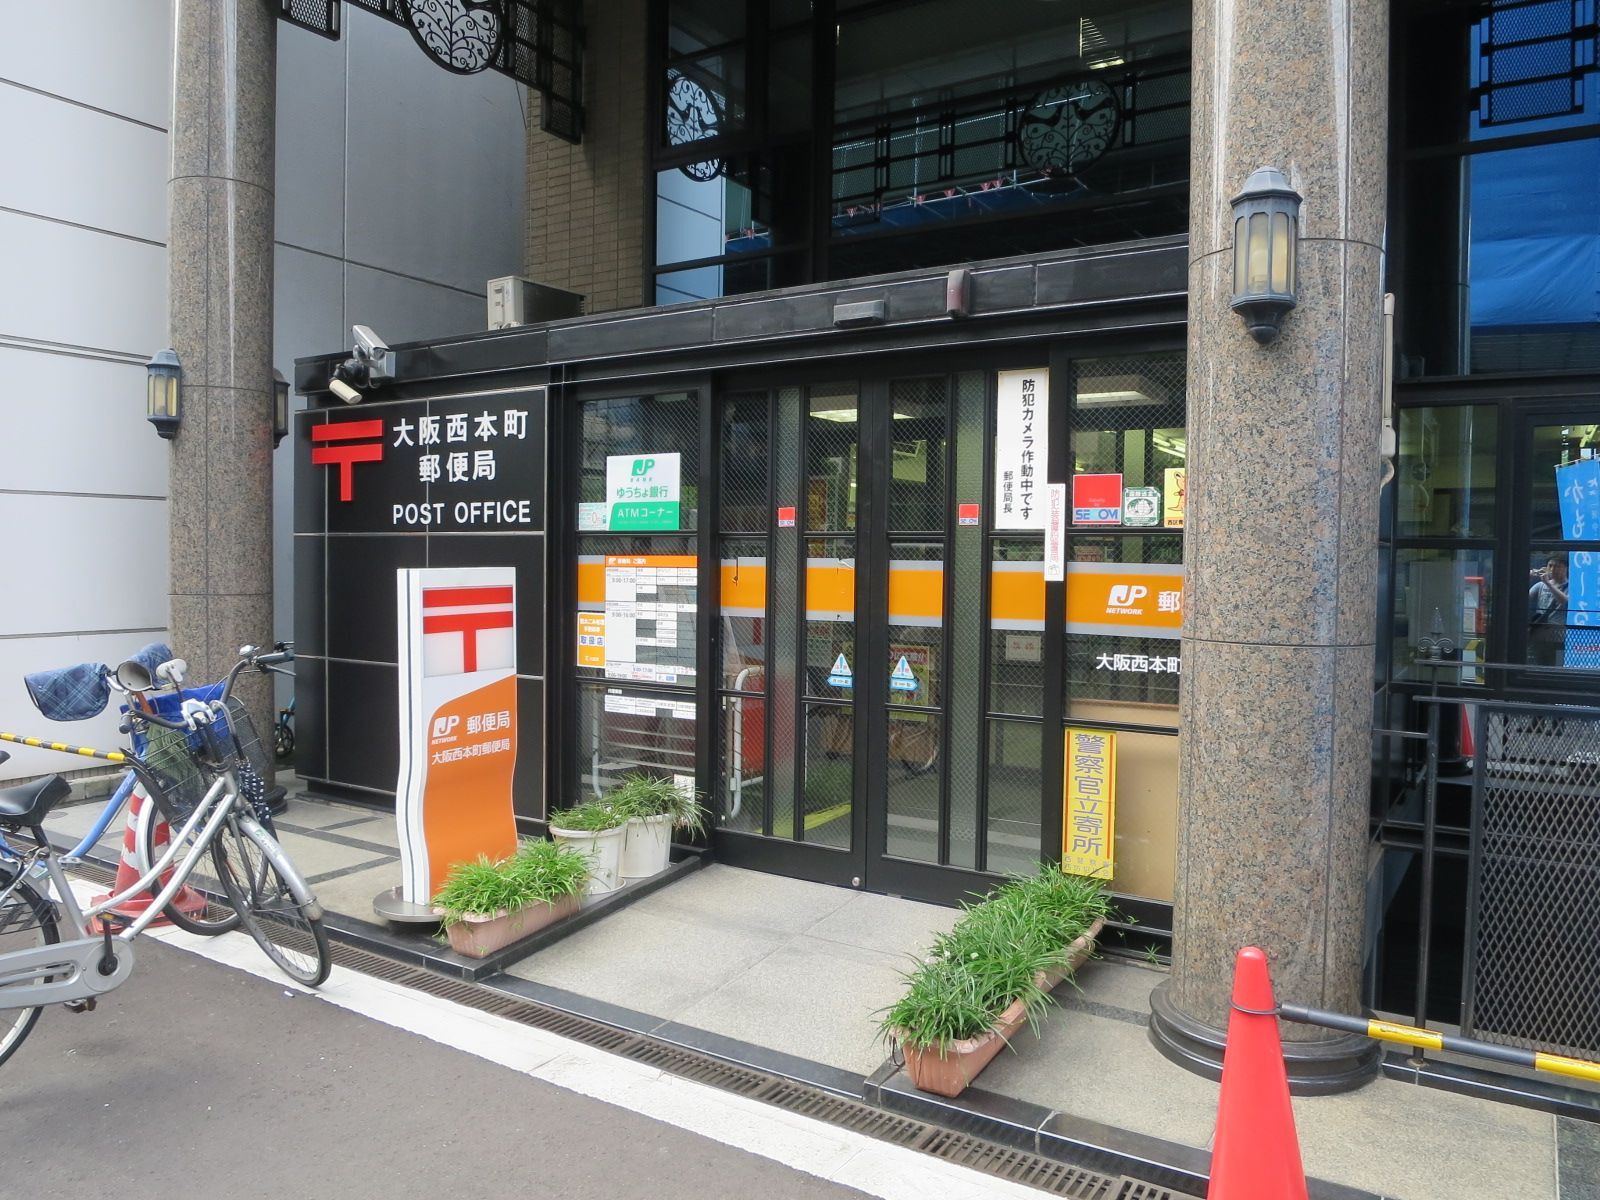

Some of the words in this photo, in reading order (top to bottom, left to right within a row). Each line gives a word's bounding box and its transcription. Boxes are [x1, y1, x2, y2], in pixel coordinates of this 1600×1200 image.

[393, 409, 528, 447] 大阪西本町
[1020, 378, 1036, 521] 防犯カメラ作動中です
[419, 450, 496, 483] 郵便局
[631, 459, 655, 476] JP
[616, 485, 669, 499] ゆうちょ銀行
[1003, 470, 1014, 514] 郵便局長
[393, 503, 445, 524] POST
[454, 500, 531, 524] OFFICE
[617, 507, 674, 518] ATMコーナー
[1105, 607, 1143, 616] NETWORK
[1107, 584, 1148, 607] JP
[1157, 586, 1184, 615] 郵
[432, 715, 460, 738] JP
[467, 710, 510, 735] 郵便局
[431, 736, 458, 745] NETWORK
[431, 738, 511, 766] 大阪西本町郵便局
[1071, 733, 1105, 856] 警察官立寄所
